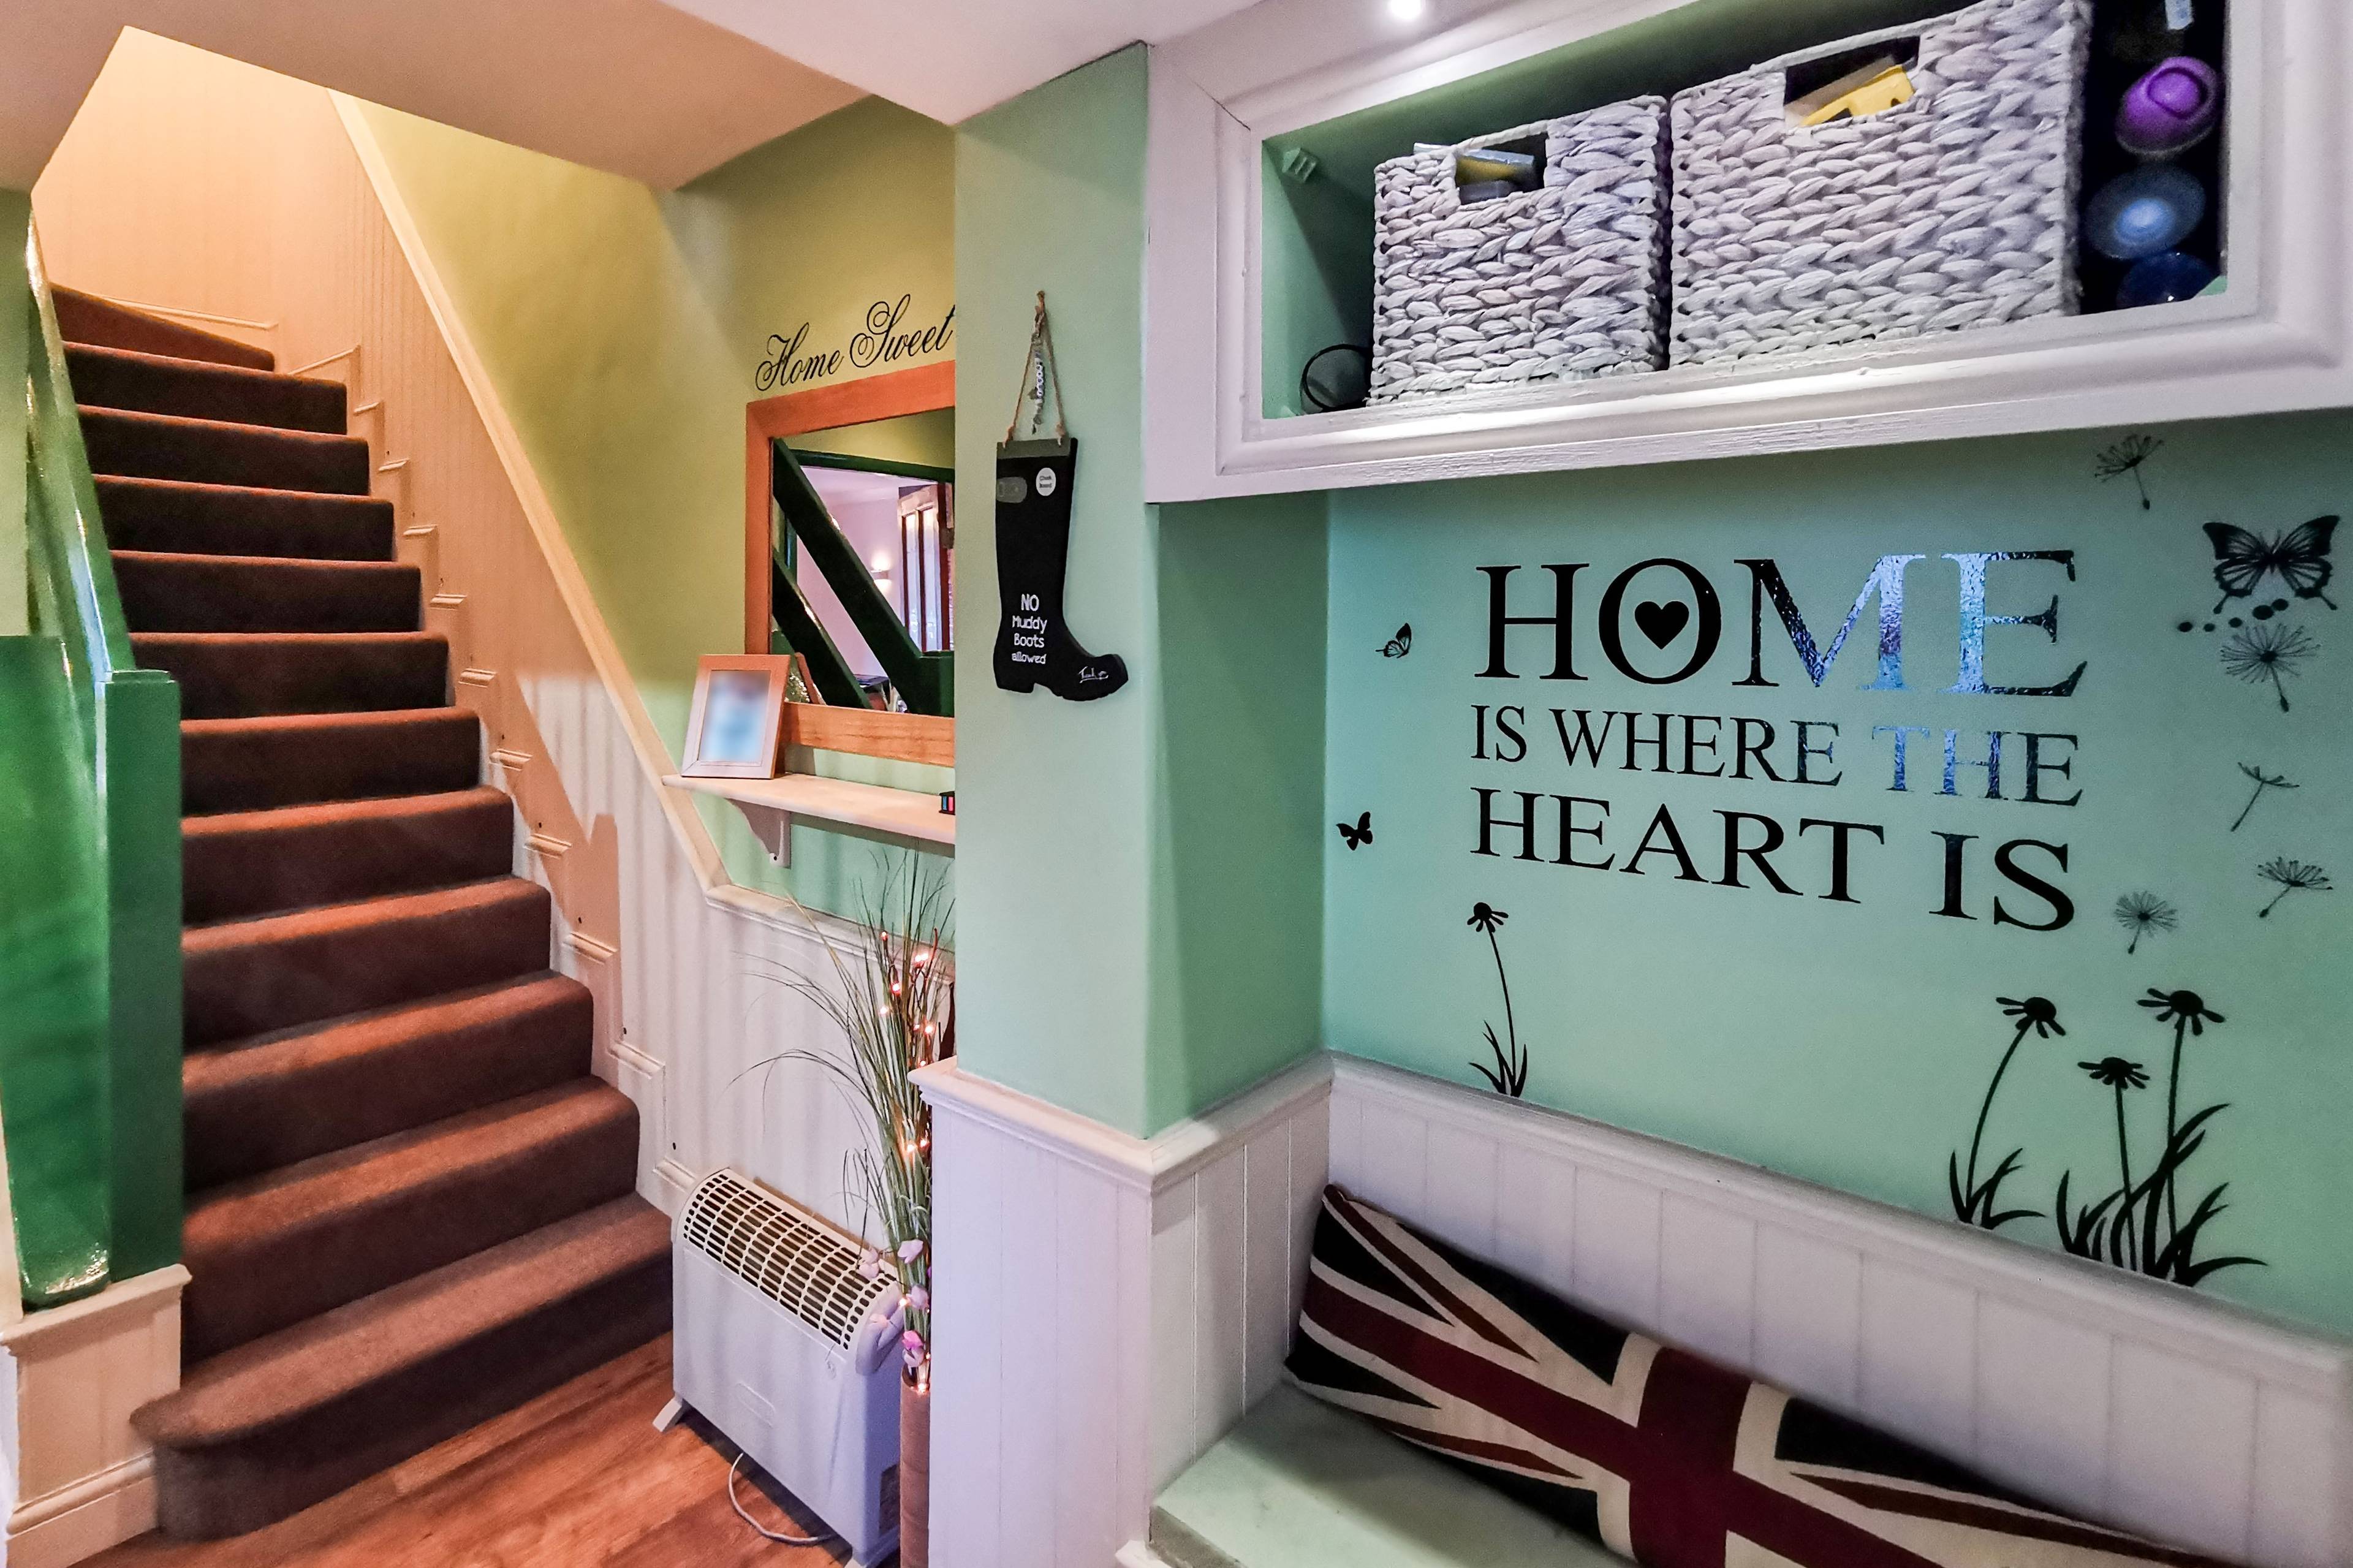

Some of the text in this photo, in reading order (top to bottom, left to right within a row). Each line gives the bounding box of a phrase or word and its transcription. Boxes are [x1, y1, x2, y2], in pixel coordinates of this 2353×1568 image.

[756, 294, 955, 391] Home Sweet
[1012, 615, 1047, 634] Muddy
[1021, 593, 1039, 611] NO
[1474, 549, 2088, 697] HOME
[1011, 651, 1047, 664] allowed
[1014, 633, 1044, 648] Boots
[1470, 704, 2084, 808] IS WHERE THE
[1469, 787, 2075, 933] HEART IS
